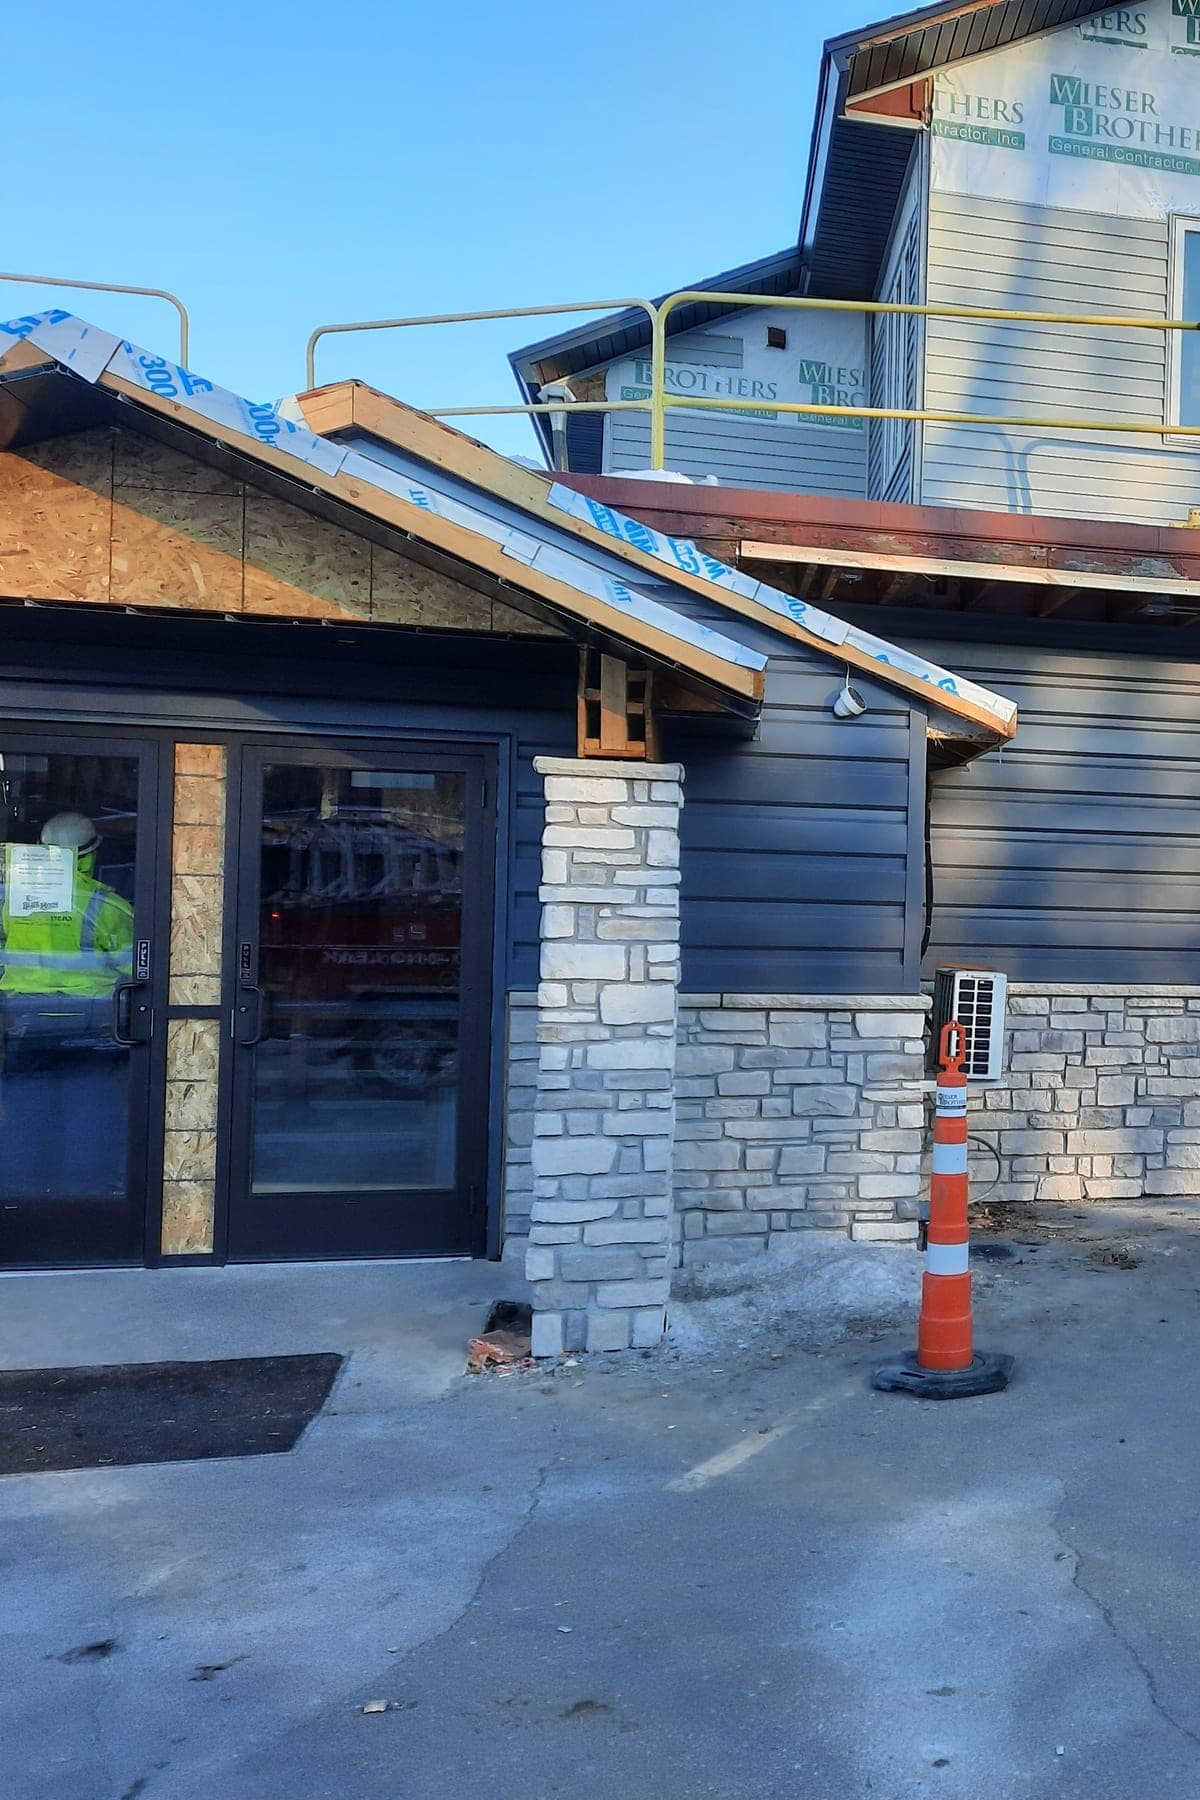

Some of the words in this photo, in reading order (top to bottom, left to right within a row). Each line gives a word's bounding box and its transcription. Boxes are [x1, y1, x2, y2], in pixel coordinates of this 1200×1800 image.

[1051, 75, 1160, 116] WIESER
[1051, 138, 1109, 158] General
[1114, 148, 1193, 173] Contractor,
